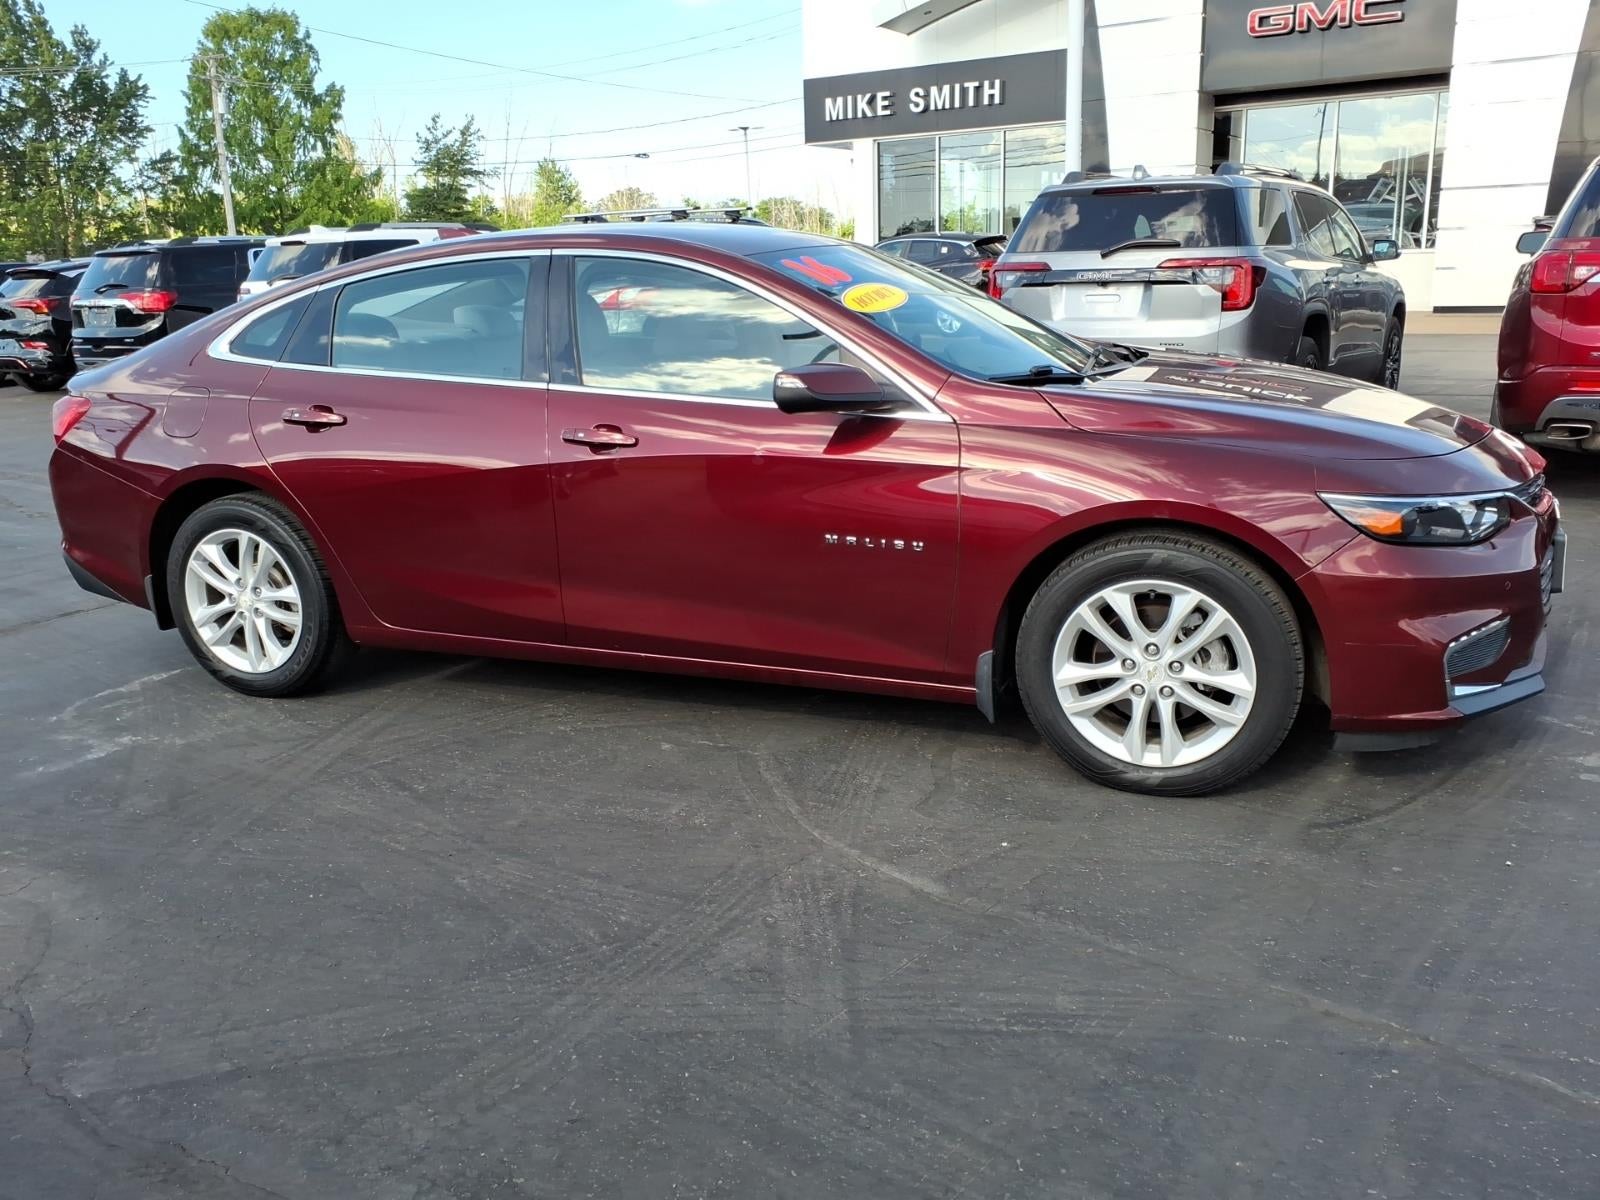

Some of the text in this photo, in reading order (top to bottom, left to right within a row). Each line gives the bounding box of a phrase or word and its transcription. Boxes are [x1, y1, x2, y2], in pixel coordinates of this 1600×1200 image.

[1247, 0, 1403, 37] GMC
[825, 78, 1002, 121] MIKE SMITH
[1077, 270, 1122, 281] GMC
[851, 291, 879, 309] HOT
[825, 534, 924, 551] MALIBU
